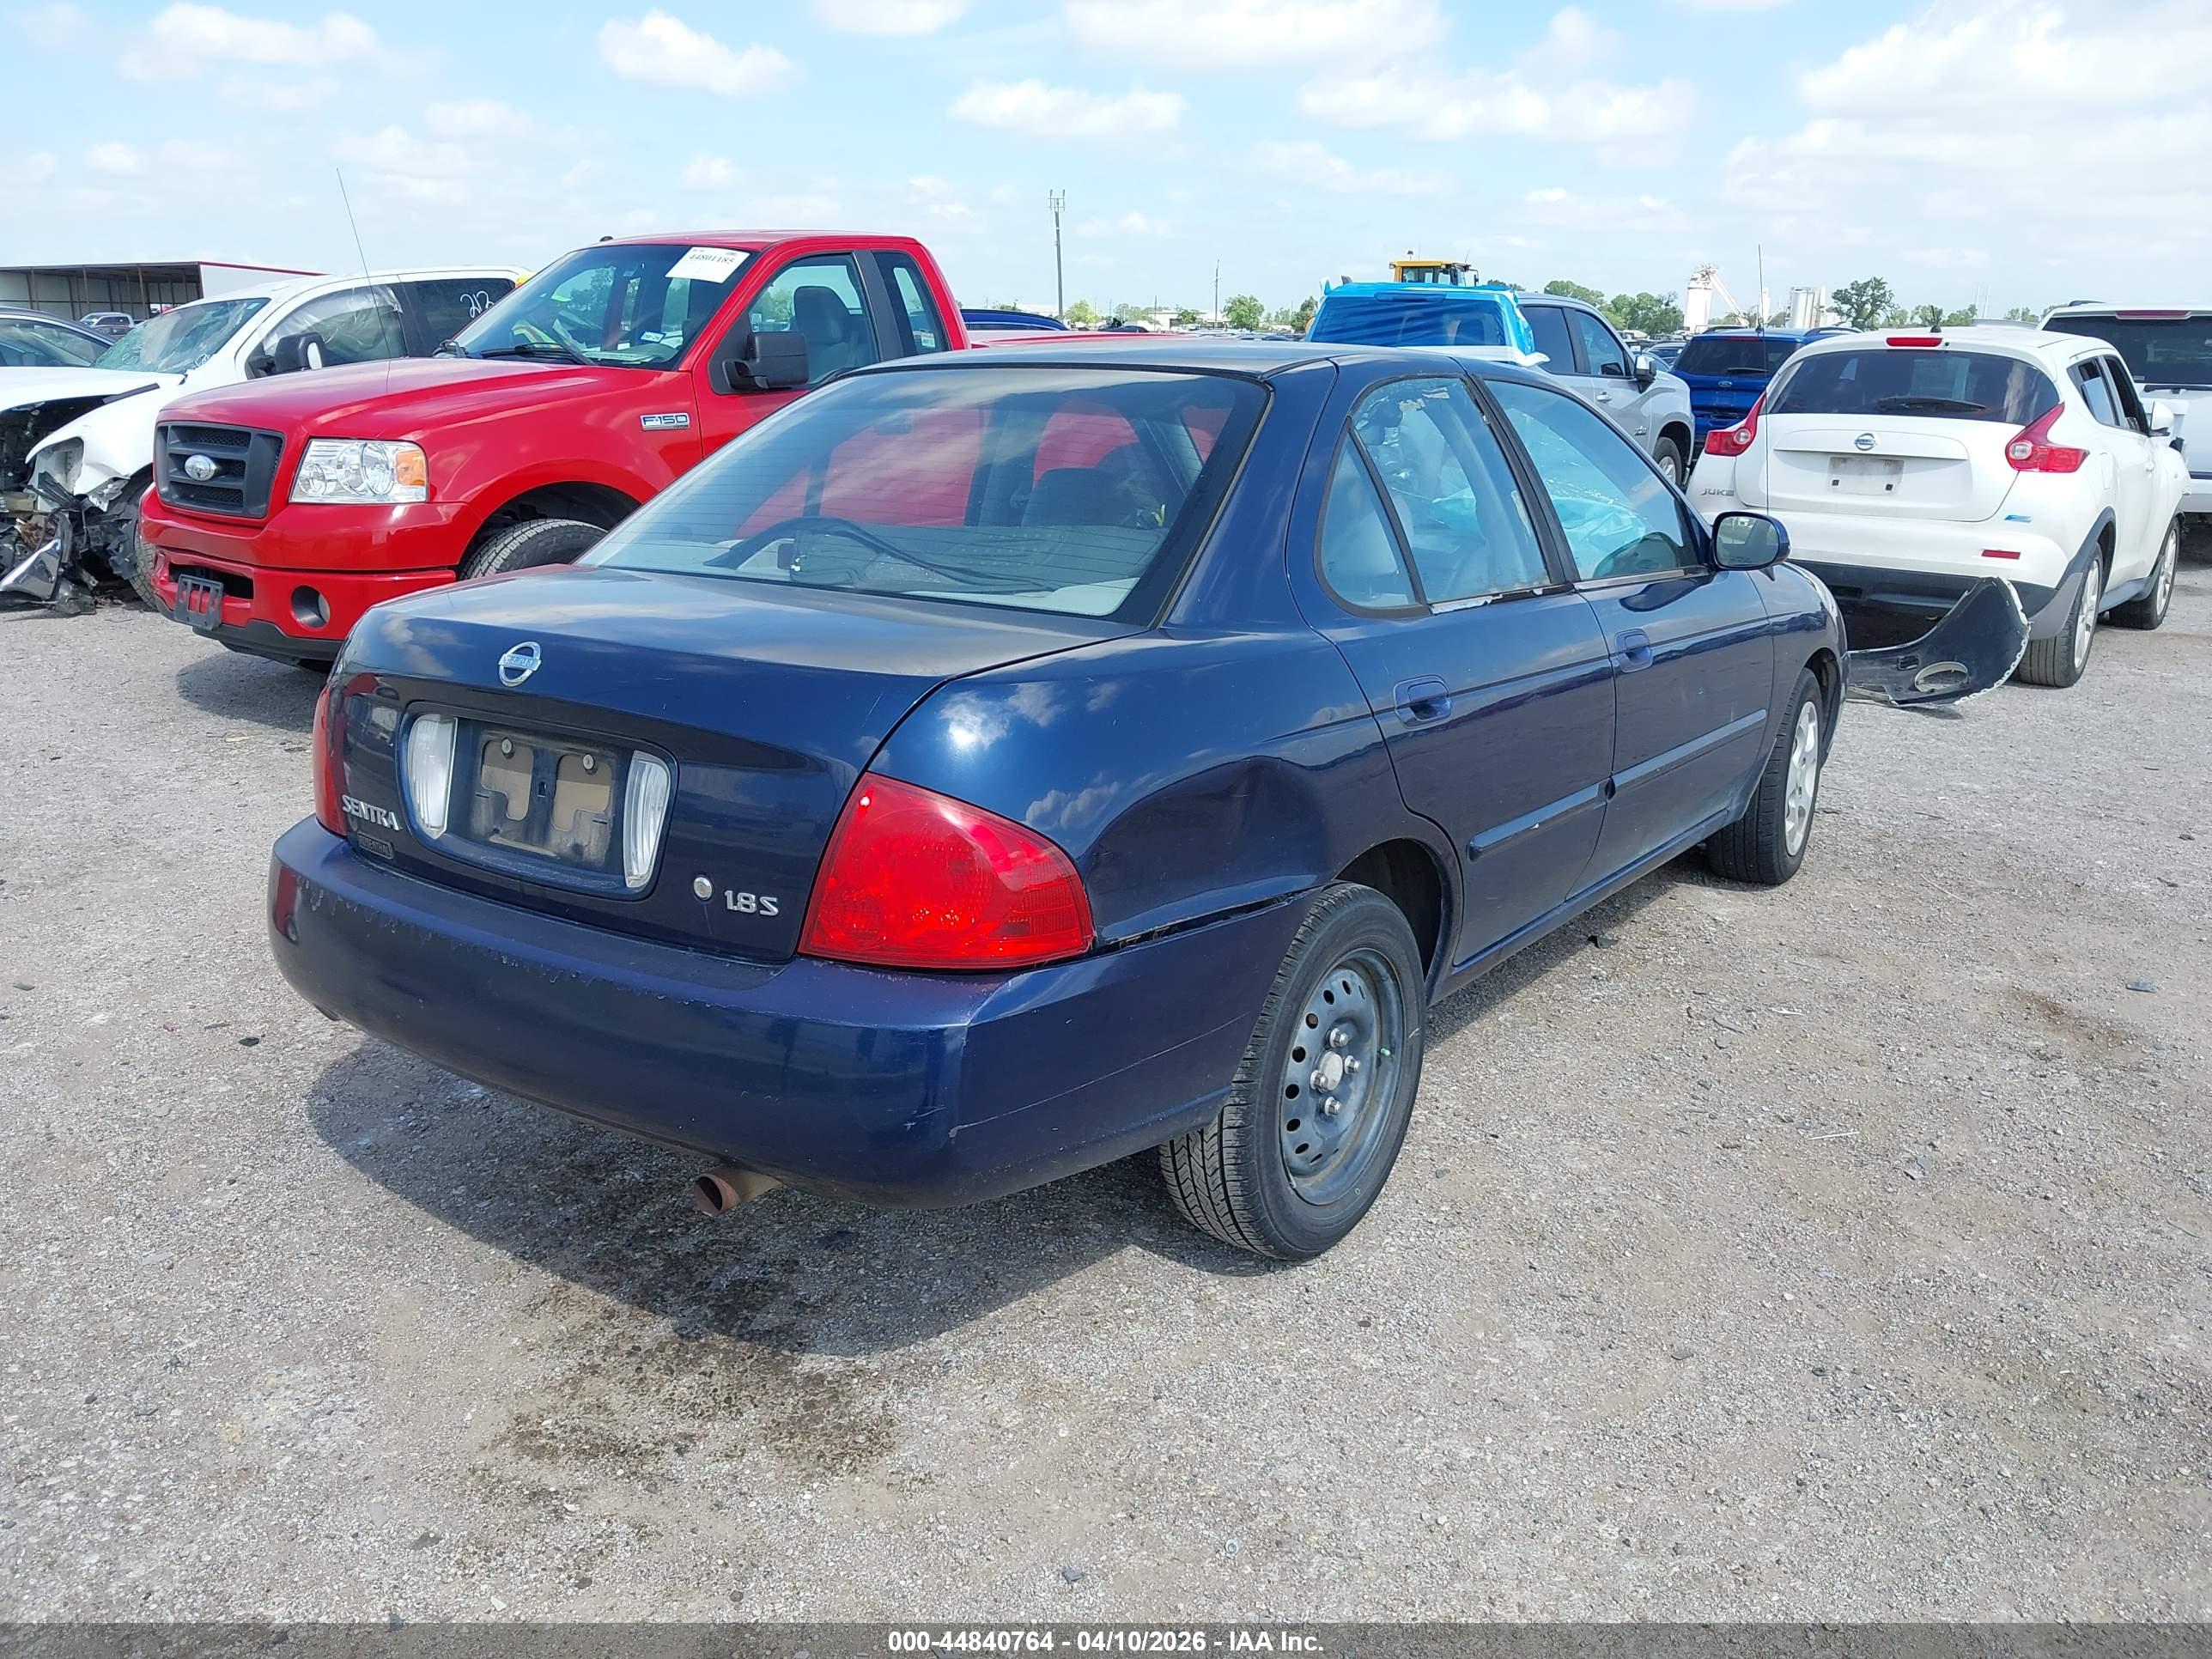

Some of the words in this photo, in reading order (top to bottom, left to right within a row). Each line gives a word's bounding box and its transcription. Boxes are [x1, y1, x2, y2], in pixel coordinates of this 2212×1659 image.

[641, 414, 689, 425] F-150
[1700, 488, 1735, 496] JUKE
[342, 794, 400, 831] SENTRA
